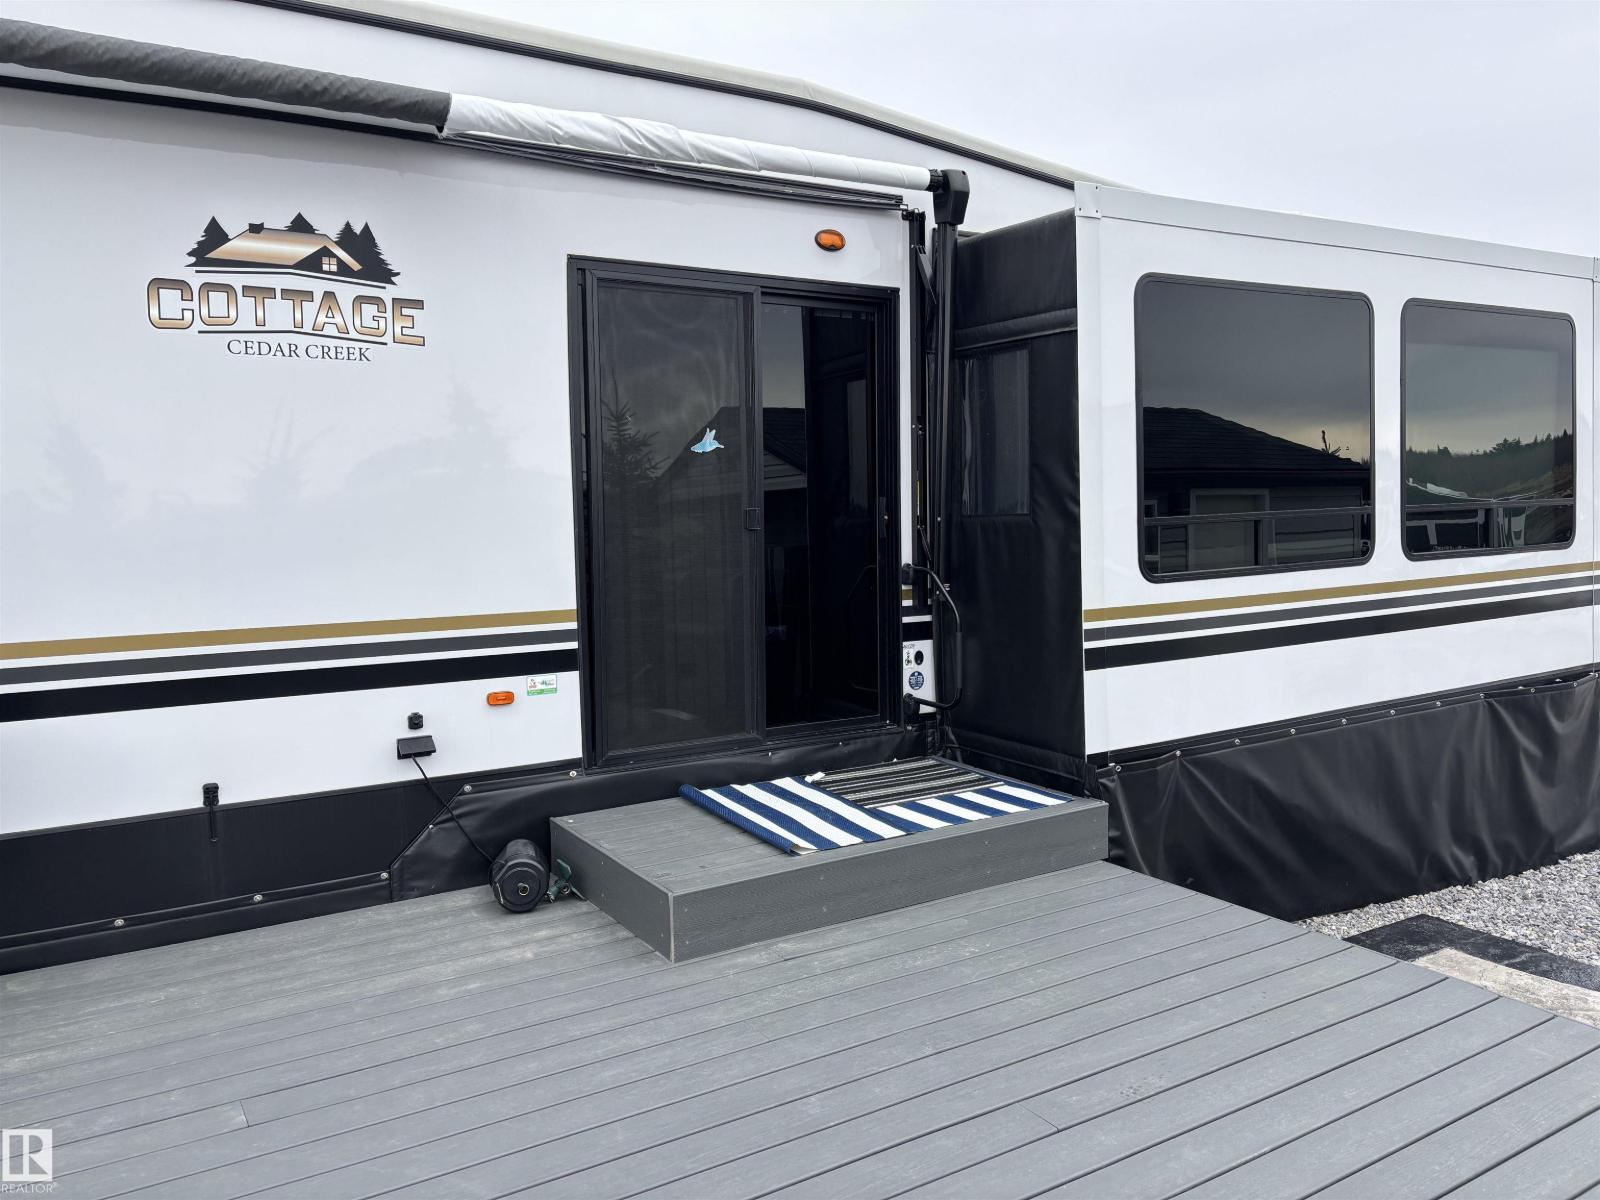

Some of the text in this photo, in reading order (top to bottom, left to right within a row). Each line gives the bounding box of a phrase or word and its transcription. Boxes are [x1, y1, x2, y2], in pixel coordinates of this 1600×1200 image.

[147, 277, 425, 347] COTTAGE
[227, 339, 372, 362] CEDAR CREEK
